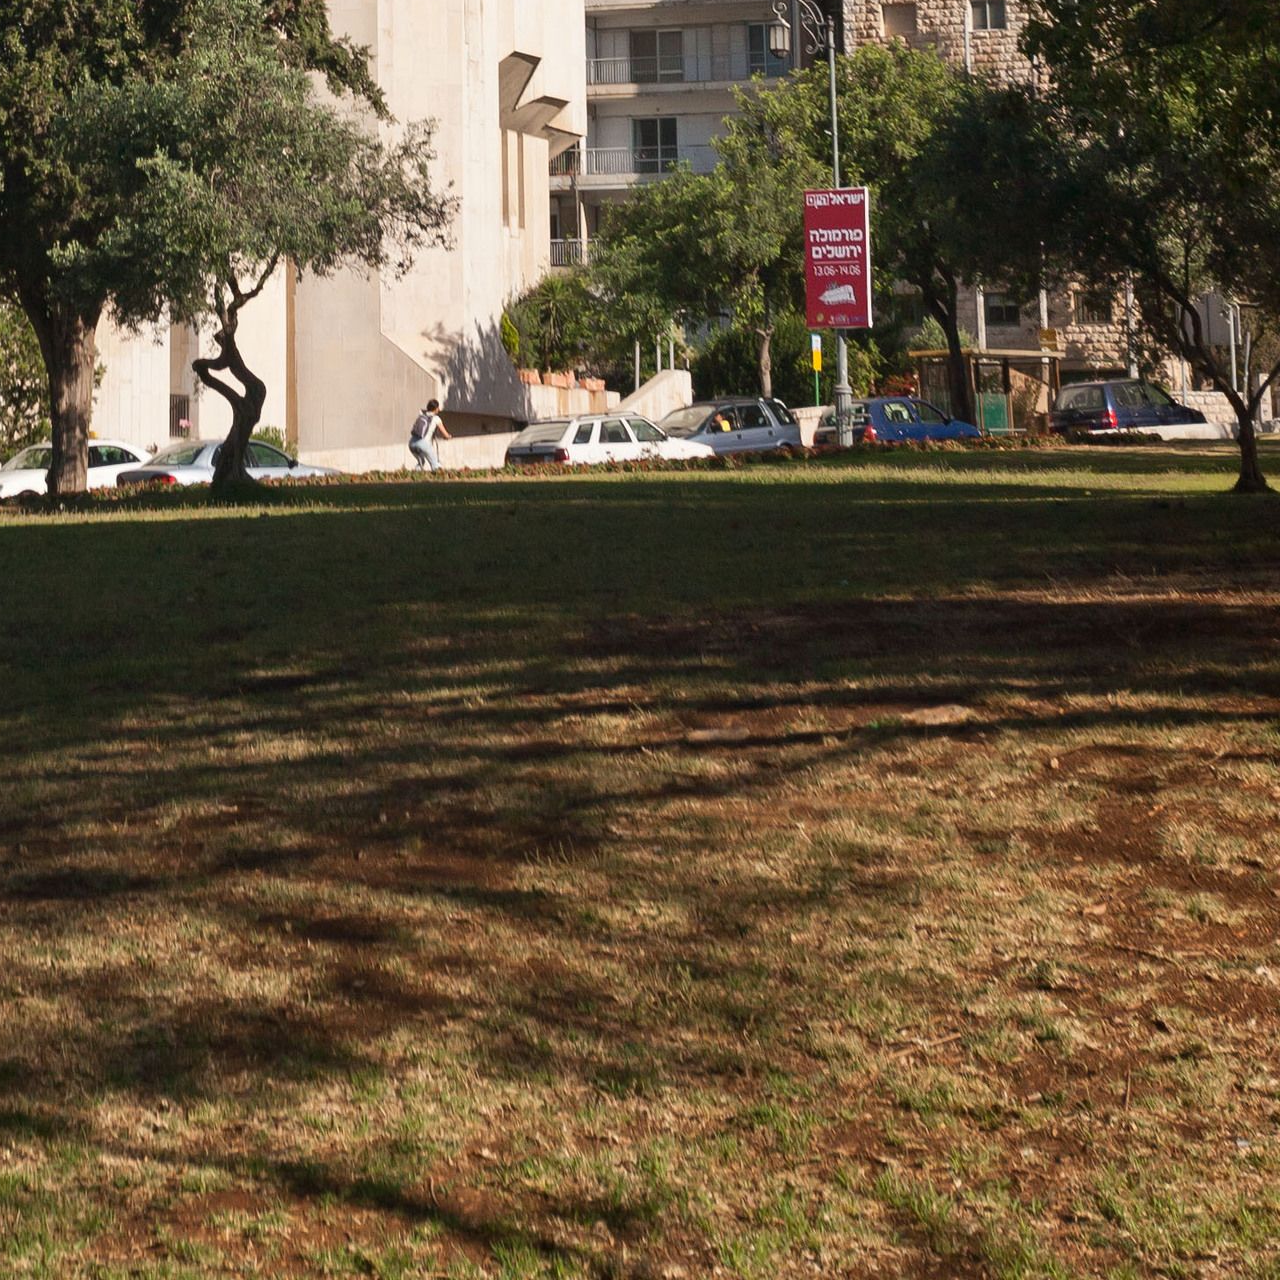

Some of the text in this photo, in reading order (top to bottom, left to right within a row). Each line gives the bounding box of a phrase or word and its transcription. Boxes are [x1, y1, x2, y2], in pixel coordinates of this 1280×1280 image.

[829, 192, 864, 205] ישראל
[809, 228, 863, 242] פורמולה
[811, 245, 862, 259] ירושלים
